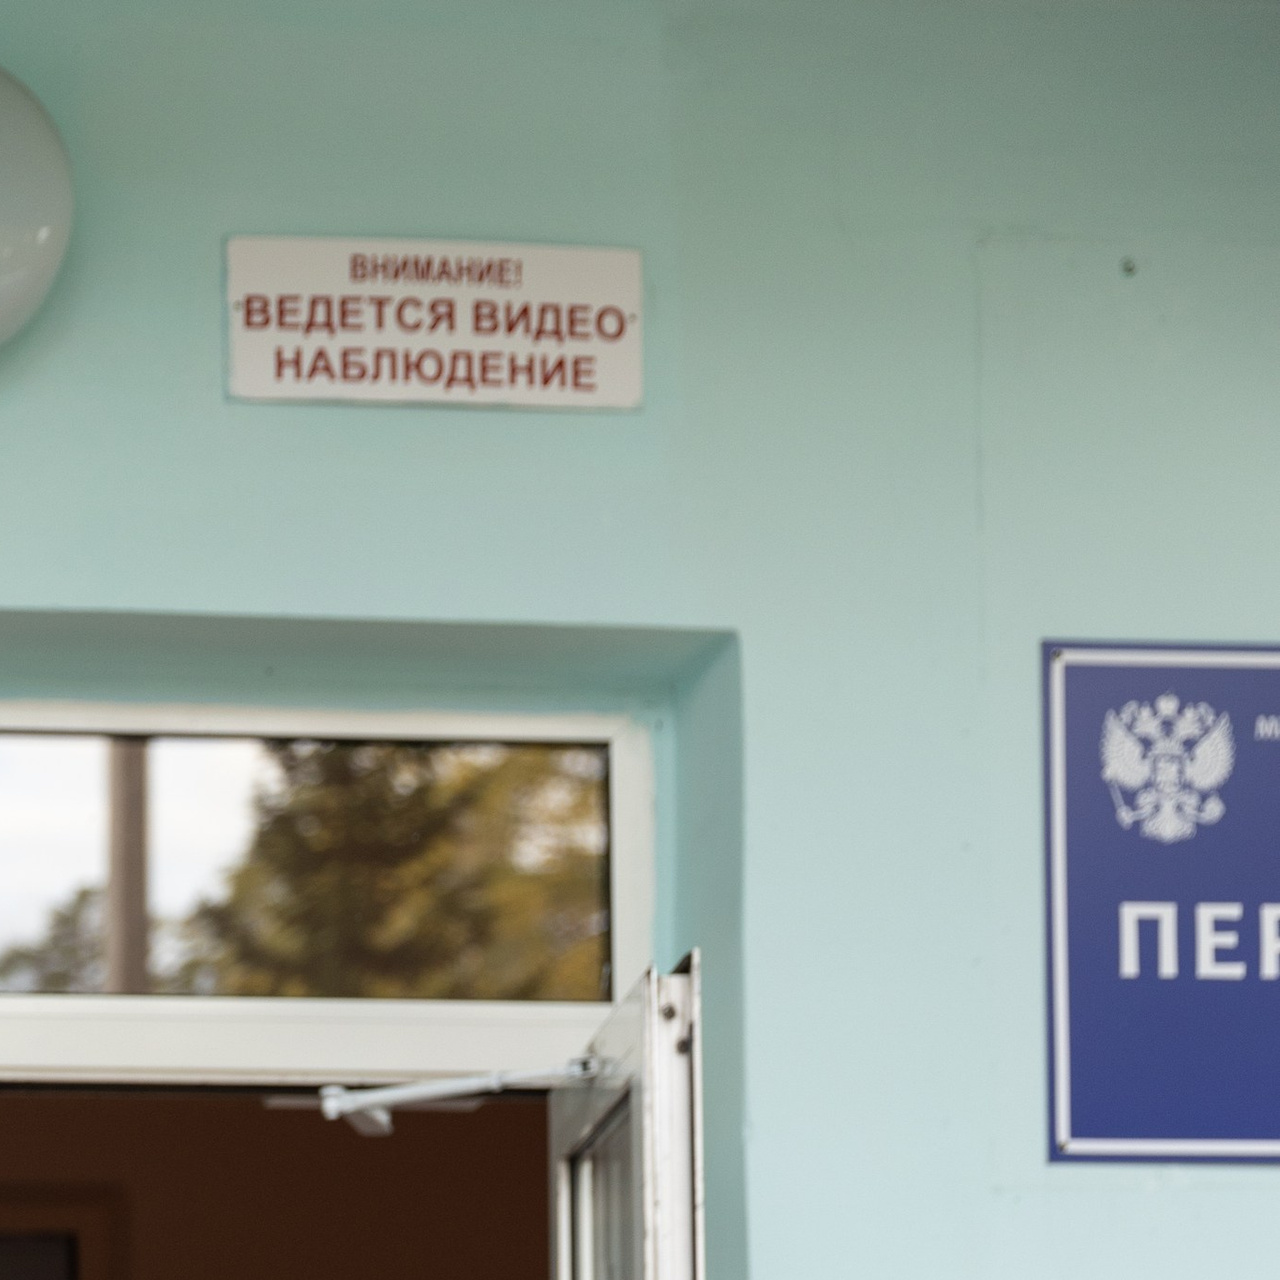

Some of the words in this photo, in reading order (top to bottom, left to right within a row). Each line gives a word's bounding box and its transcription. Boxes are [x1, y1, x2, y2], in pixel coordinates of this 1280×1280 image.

[349, 253, 523, 288] ВНИМАНИЕ!
[242, 294, 456, 338] ВЕДЕТСЯ
[473, 300, 628, 344] ВИДЕО
[273, 346, 599, 392] НАБЛЮДЕНИЕ
